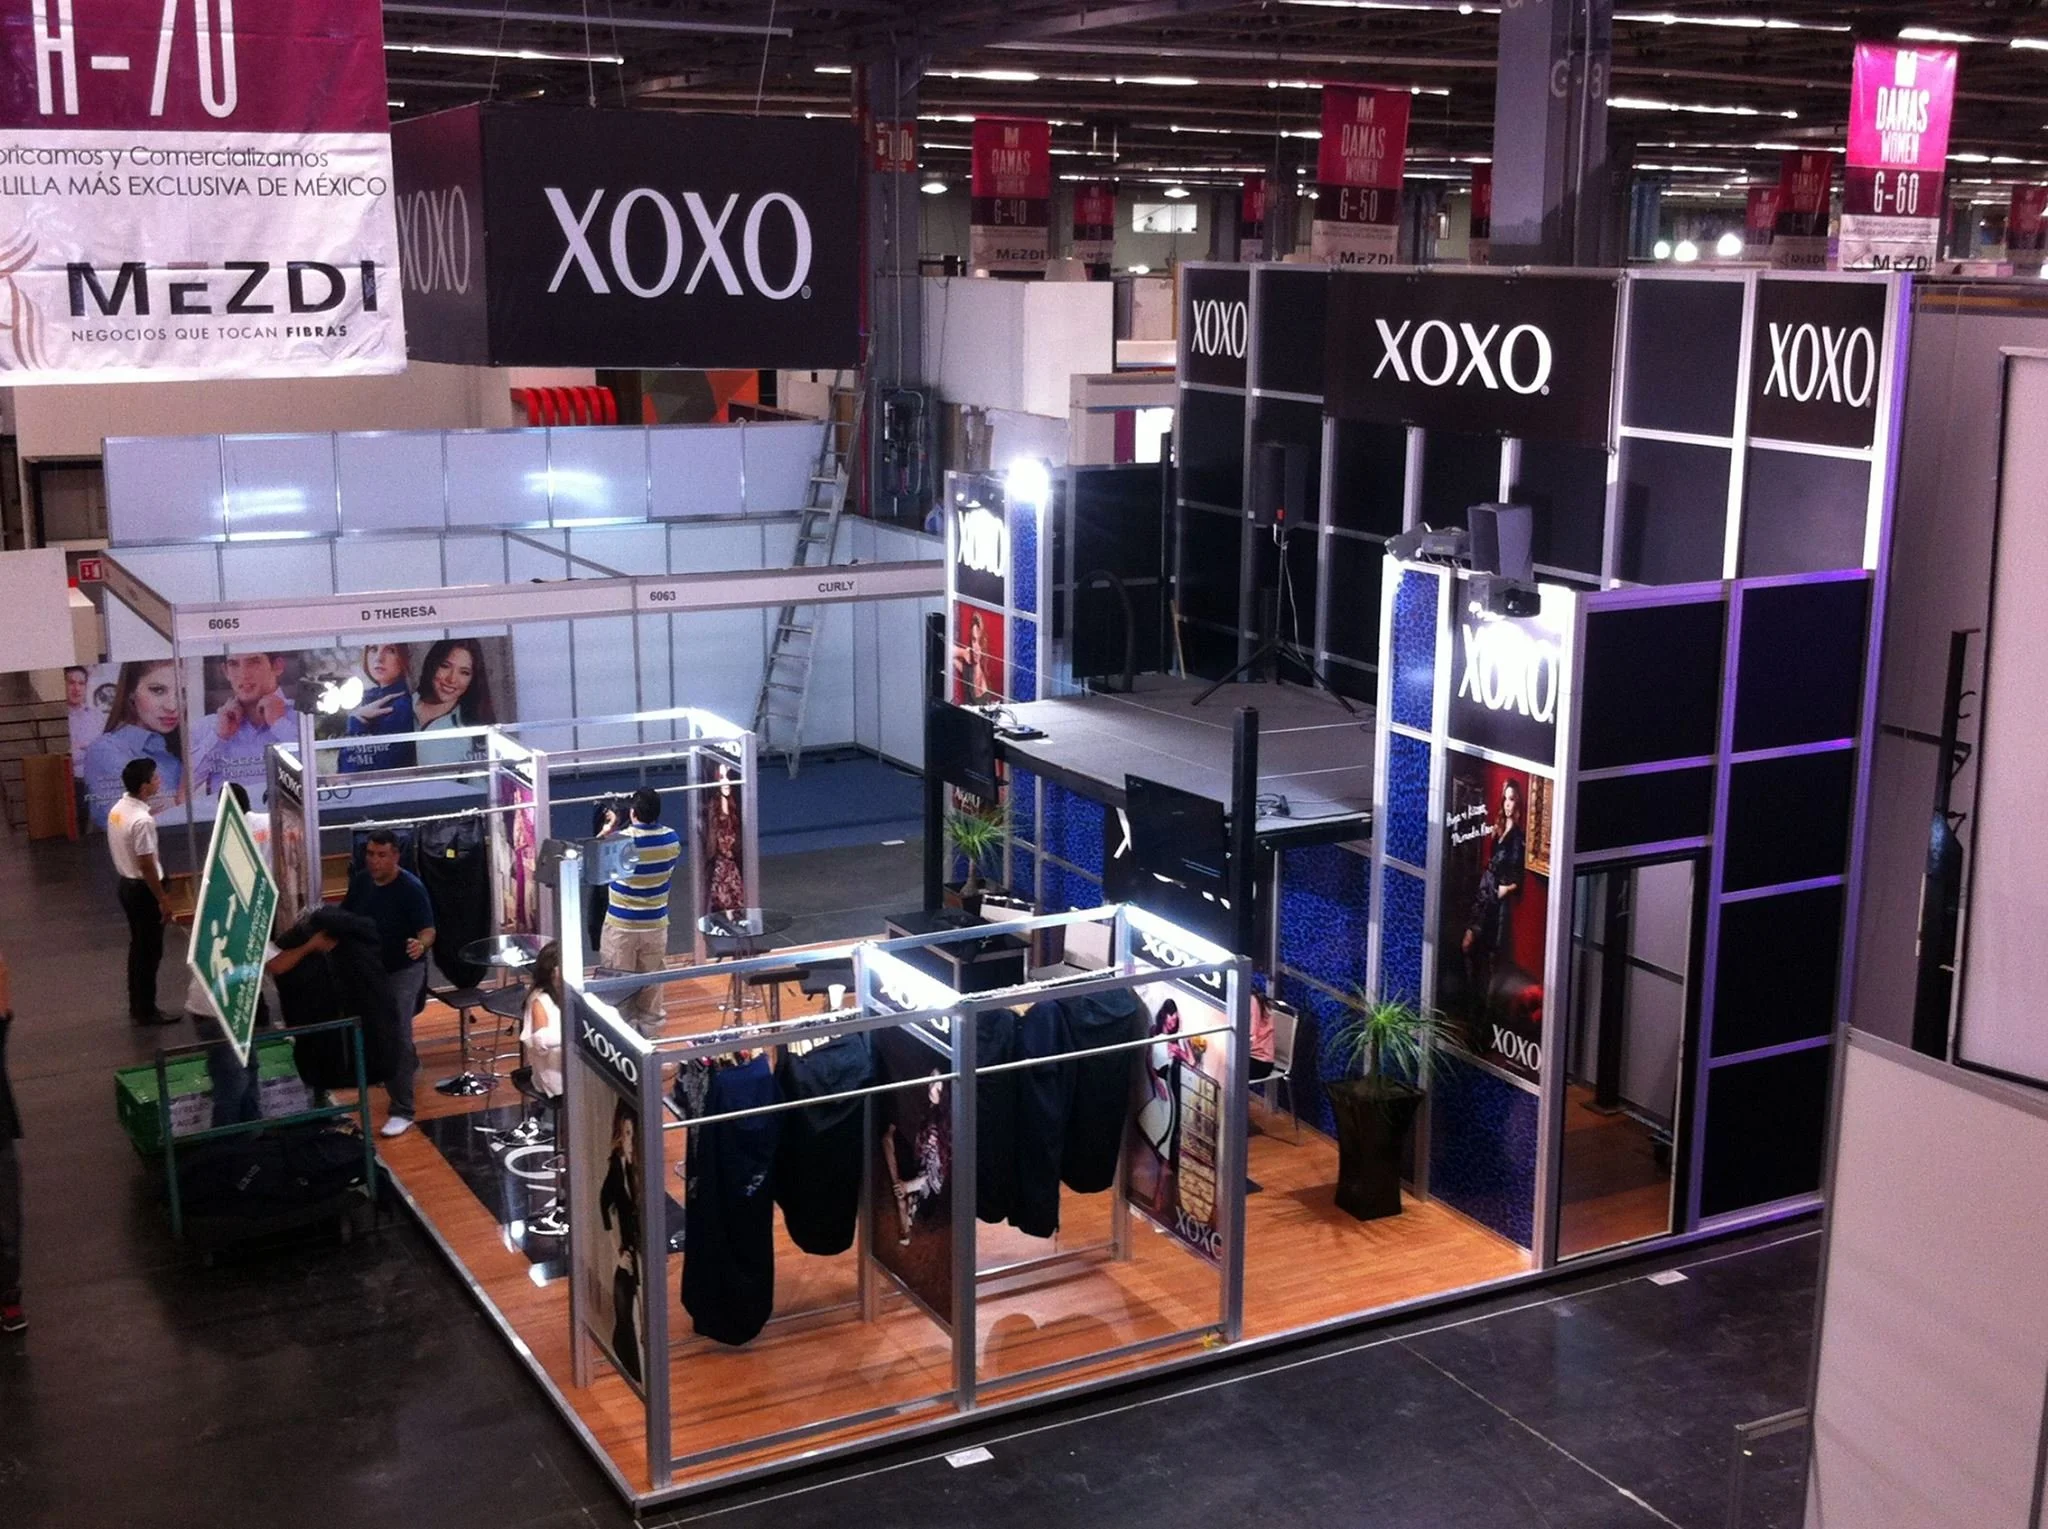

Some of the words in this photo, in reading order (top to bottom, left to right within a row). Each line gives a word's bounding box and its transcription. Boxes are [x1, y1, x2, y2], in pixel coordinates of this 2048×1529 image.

[1875, 86, 1930, 134] DAMAS
[110, 149, 122, 170] y
[129, 146, 329, 168] Comercializamos
[1341, 123, 1387, 159] DAMAS
[1880, 131, 1919, 164] WOMEN
[991, 149, 1031, 175] DAMAS
[0, 176, 62, 196] LILLA
[68, 171, 122, 197] MÁS
[128, 176, 251, 197] EXCLUSIVA
[257, 177, 288, 197] DE
[294, 173, 387, 197] MÉXICO
[1873, 170, 1920, 215] G-60
[994, 199, 1027, 224] G-40
[1339, 188, 1378, 221] G-50
[397, 185, 470, 295] XOXO
[544, 187, 813, 300] XOXO
[66, 260, 378, 317] MEZDI
[71, 327, 167, 343] NEGOCIOS
[175, 327, 209, 341] QUE
[217, 327, 278, 340] TOCAN
[286, 325, 348, 339] FIBRAS
[1191, 299, 1248, 359] XOXO
[1372, 318, 1553, 395] XOXO
[1763, 322, 1876, 408] XOXO
[649, 591, 676, 601] 6063
[818, 581, 855, 593] CURLY
[208, 617, 240, 630] 6065
[361, 610, 371, 621] D
[374, 605, 437, 620] THERESA
[583, 1020, 638, 1083] XOXO
[1490, 1023, 1542, 1071] XOXO
